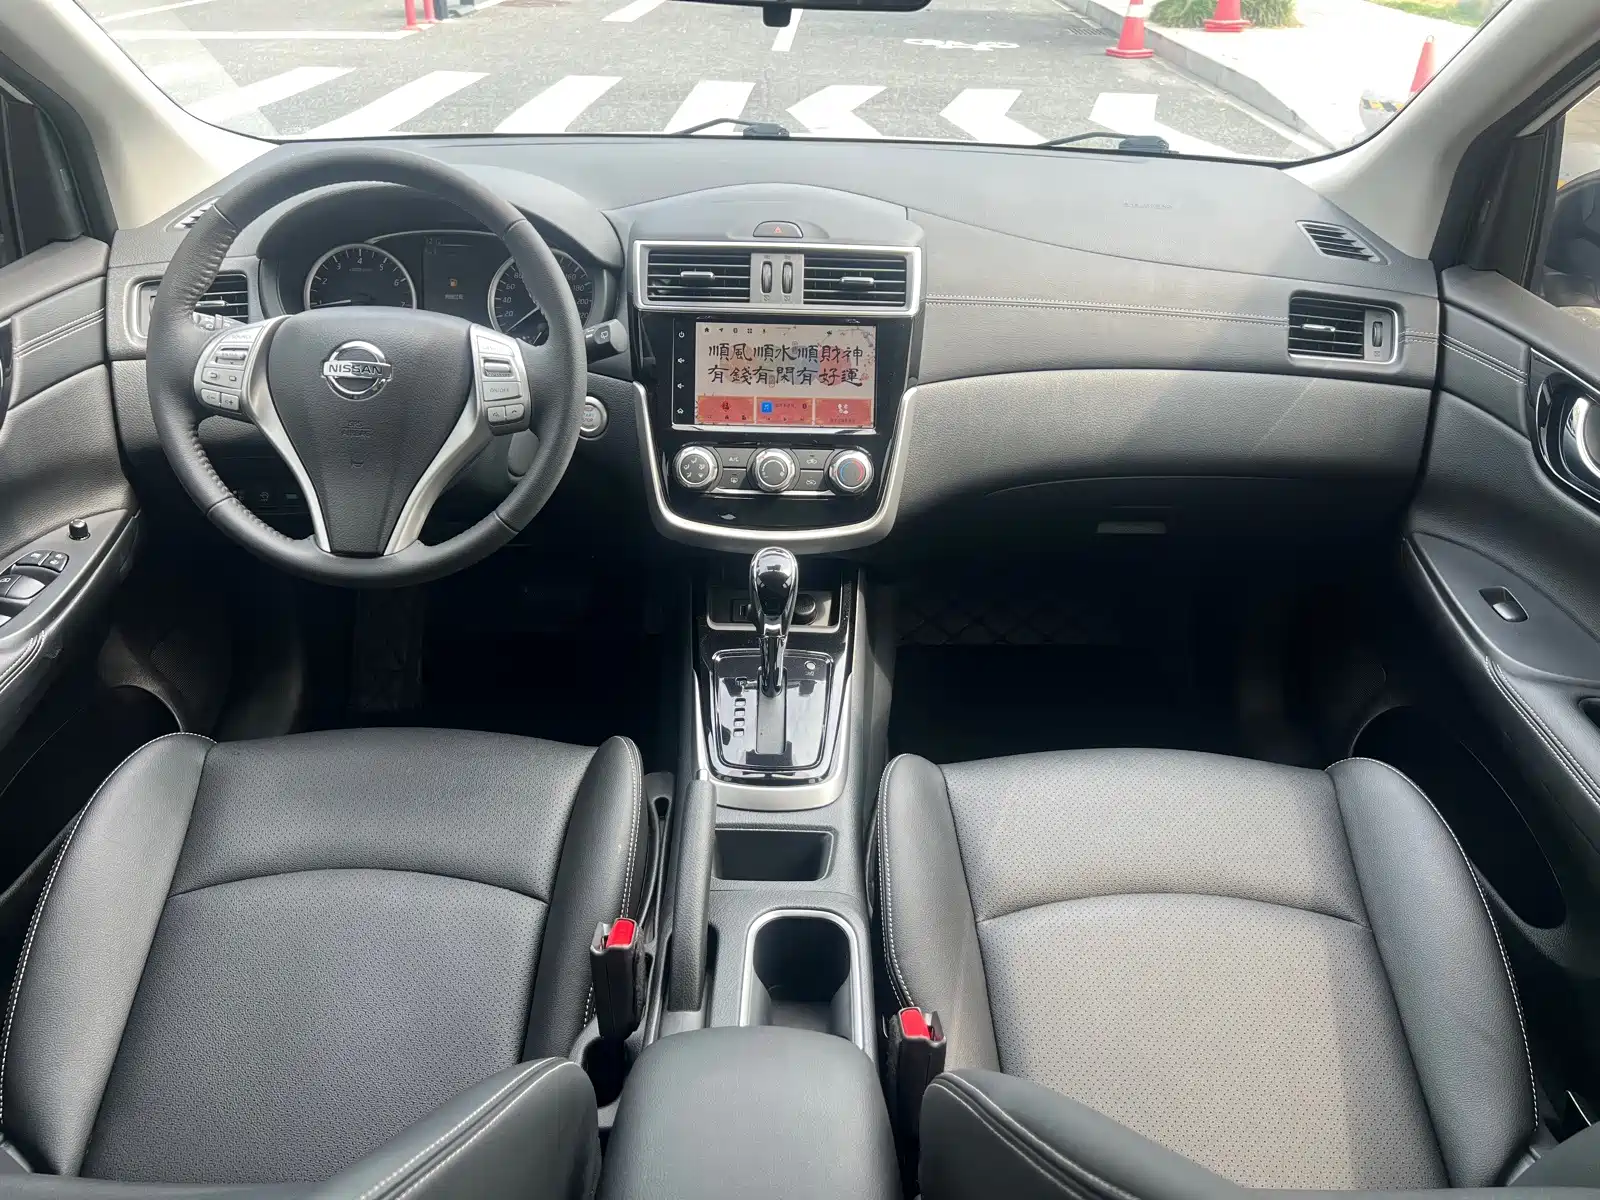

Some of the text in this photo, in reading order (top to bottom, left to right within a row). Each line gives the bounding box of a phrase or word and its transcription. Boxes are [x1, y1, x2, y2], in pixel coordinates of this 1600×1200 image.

[503, 296, 512, 304] 40
[709, 343, 863, 366] 順風順水順財神
[328, 364, 383, 375] NISSAN
